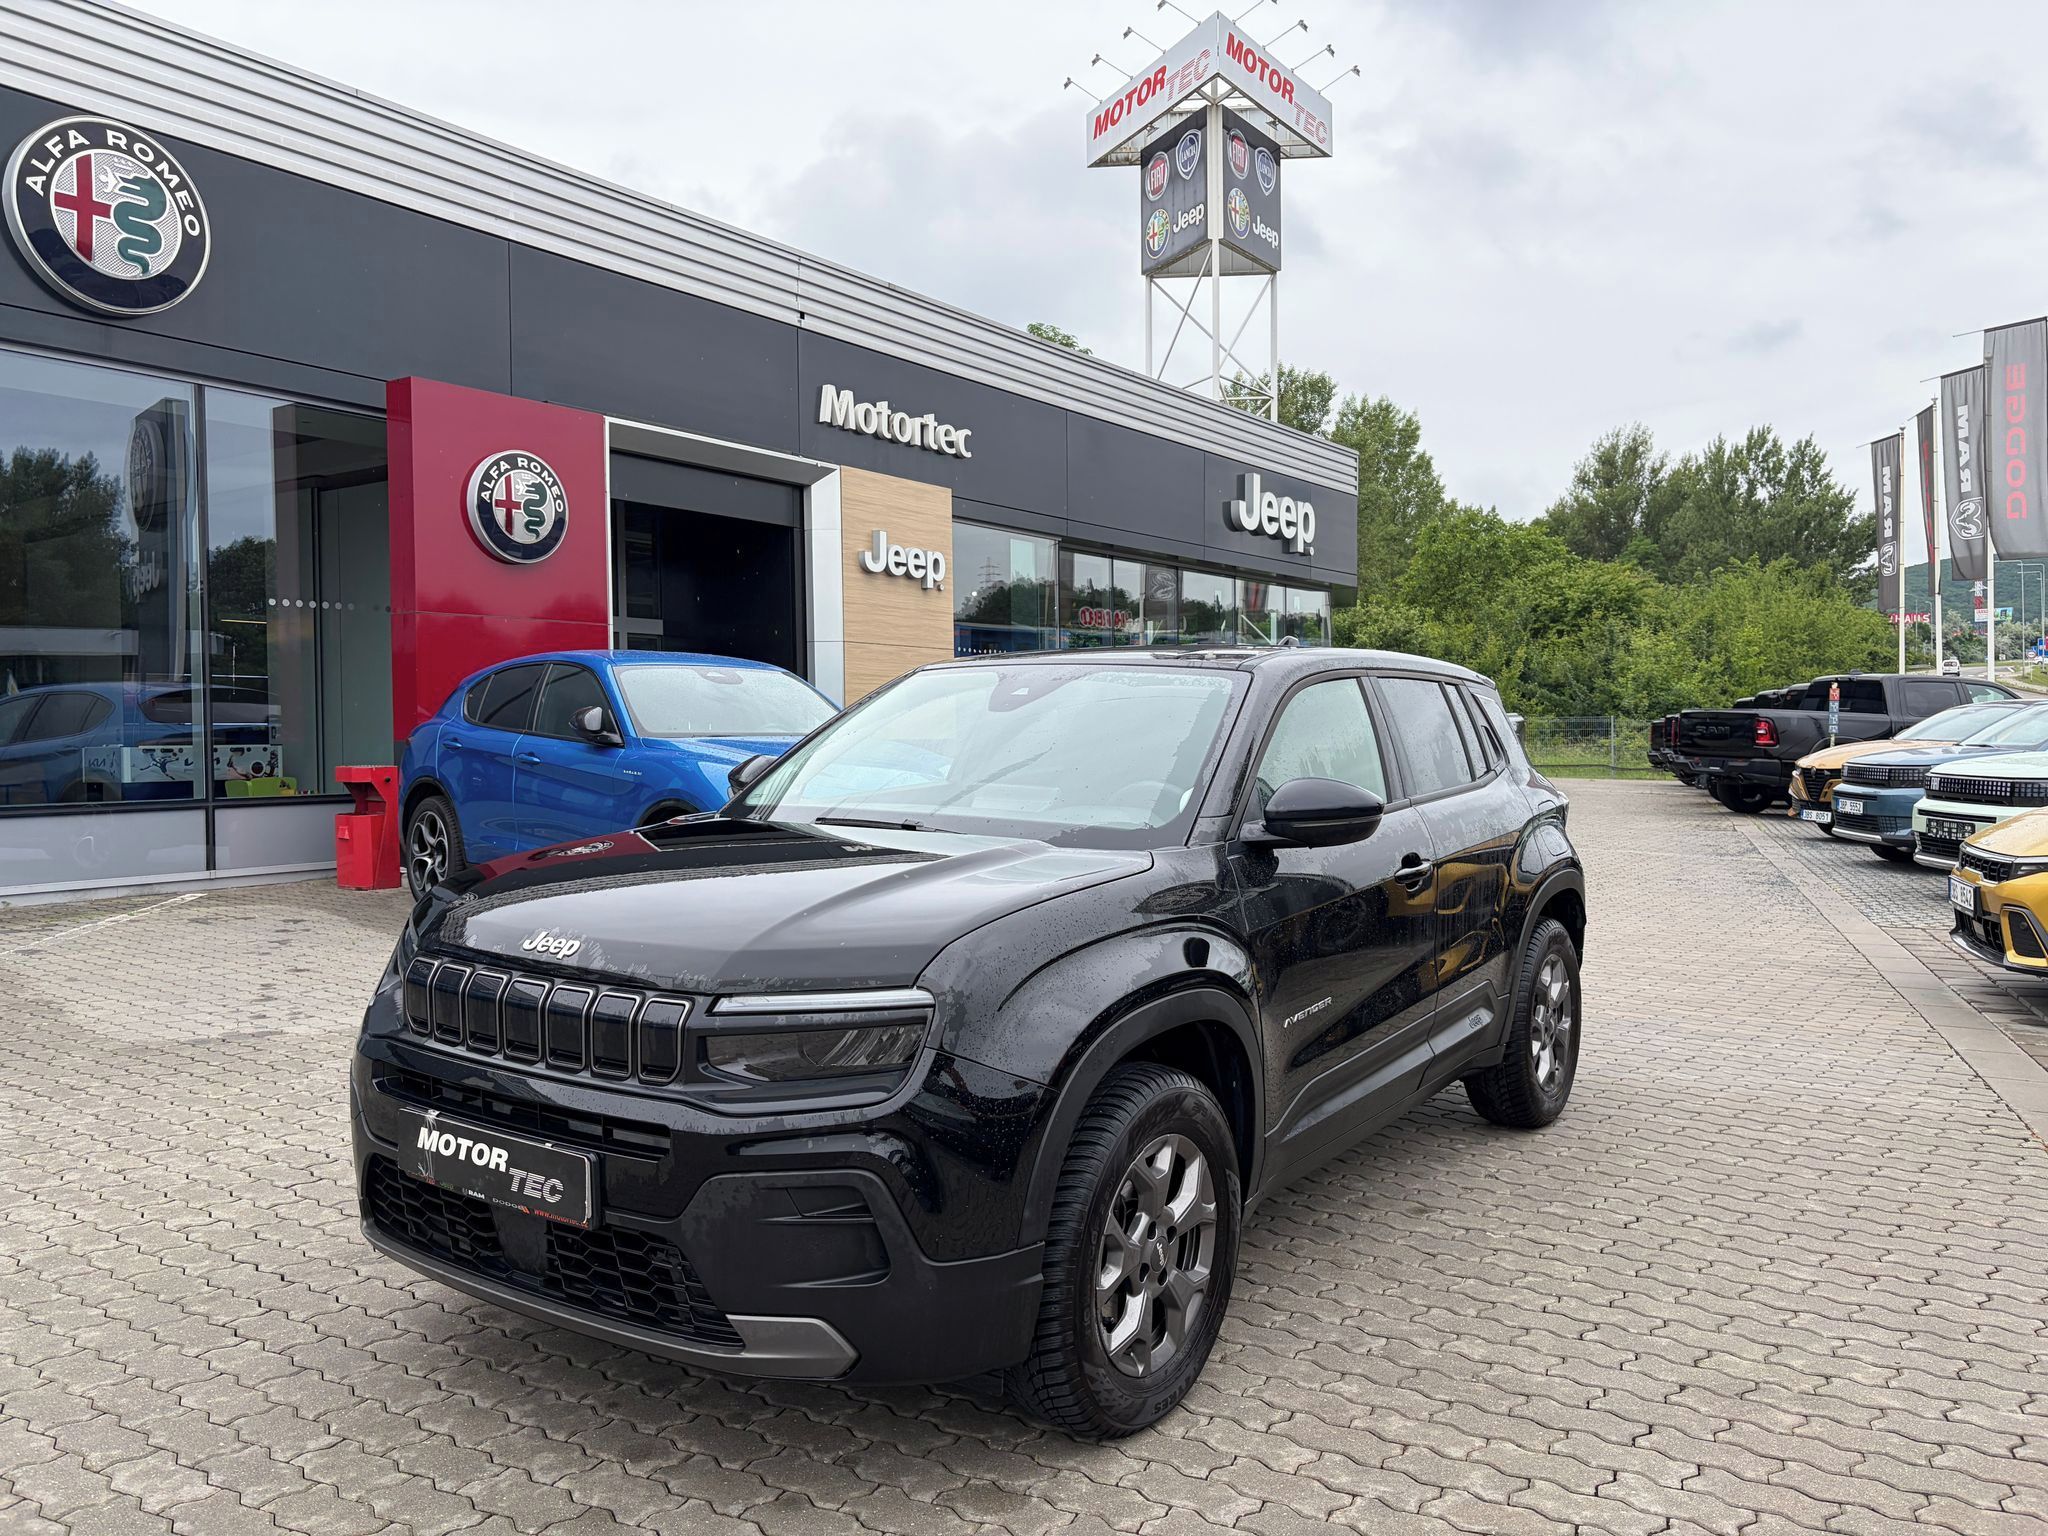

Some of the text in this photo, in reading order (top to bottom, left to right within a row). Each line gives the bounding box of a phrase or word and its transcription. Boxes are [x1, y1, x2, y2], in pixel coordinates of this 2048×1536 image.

[1092, 48, 1212, 141] MOTOR TEC
[1225, 31, 1328, 145] MOTOR TEC
[1150, 163, 1165, 191] FIAT
[1232, 140, 1246, 168] FIAT
[25, 129, 200, 237] ALFA ROMEO
[1172, 203, 1205, 234] Jeep
[1252, 215, 1279, 249] Jeep
[818, 383, 973, 459] Motortec
[480, 457, 564, 513] ALFA ROMEO
[1231, 472, 1316, 556] Jeep
[859, 529, 946, 591] Jeep
[522, 931, 581, 960] Jeep
[1283, 996, 1332, 1028] AVENGER
[417, 1126, 564, 1203] MOTOR TEC
[468, 1189, 485, 1199] RAM
